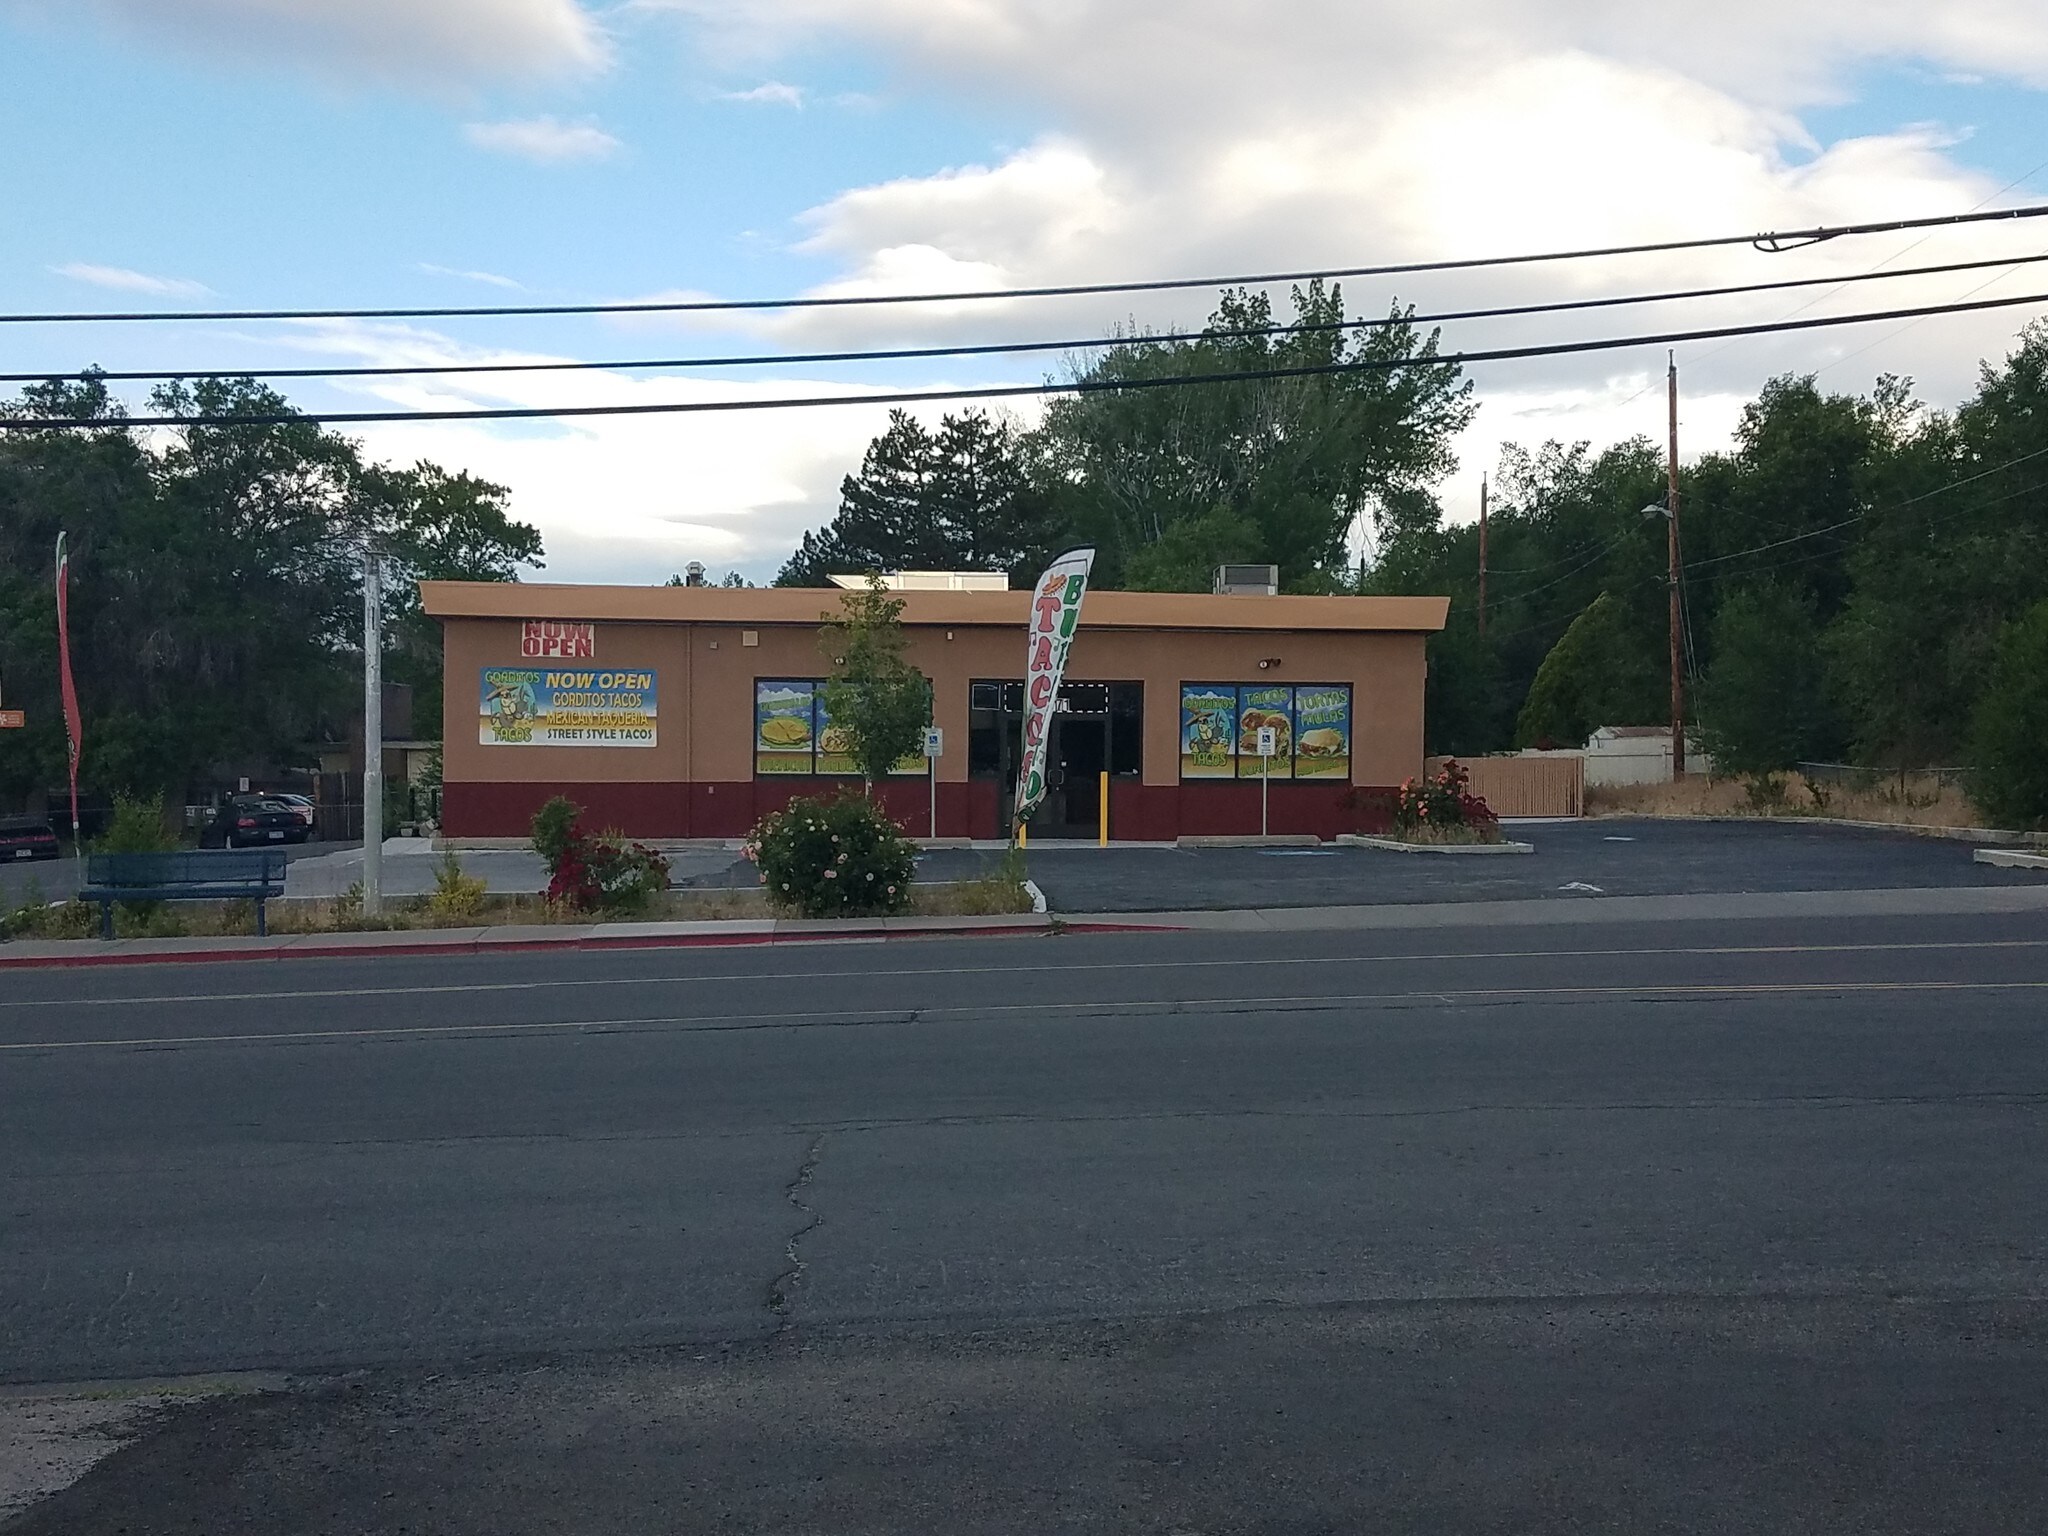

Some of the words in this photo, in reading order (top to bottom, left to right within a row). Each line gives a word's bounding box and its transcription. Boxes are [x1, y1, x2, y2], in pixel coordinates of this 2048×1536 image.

[525, 622, 590, 639] NOW
[523, 638, 592, 656] OPEN
[485, 671, 540, 683] GORDITOS
[546, 672, 595, 689] NOW
[599, 673, 652, 690] OPEN
[552, 692, 606, 707] GORDITOS
[608, 693, 642, 708] TACOS
[1245, 688, 1288, 706] TACOS
[1298, 690, 1348, 710] TORTAS
[546, 711, 593, 725] MEXICAN
[596, 712, 649, 726] TAQUERIA
[492, 727, 532, 742] TACOS
[547, 729, 584, 739] STREET
[587, 729, 617, 740] STYLE
[620, 730, 653, 740] TACOS
[1191, 752, 1227, 766] TACOS
